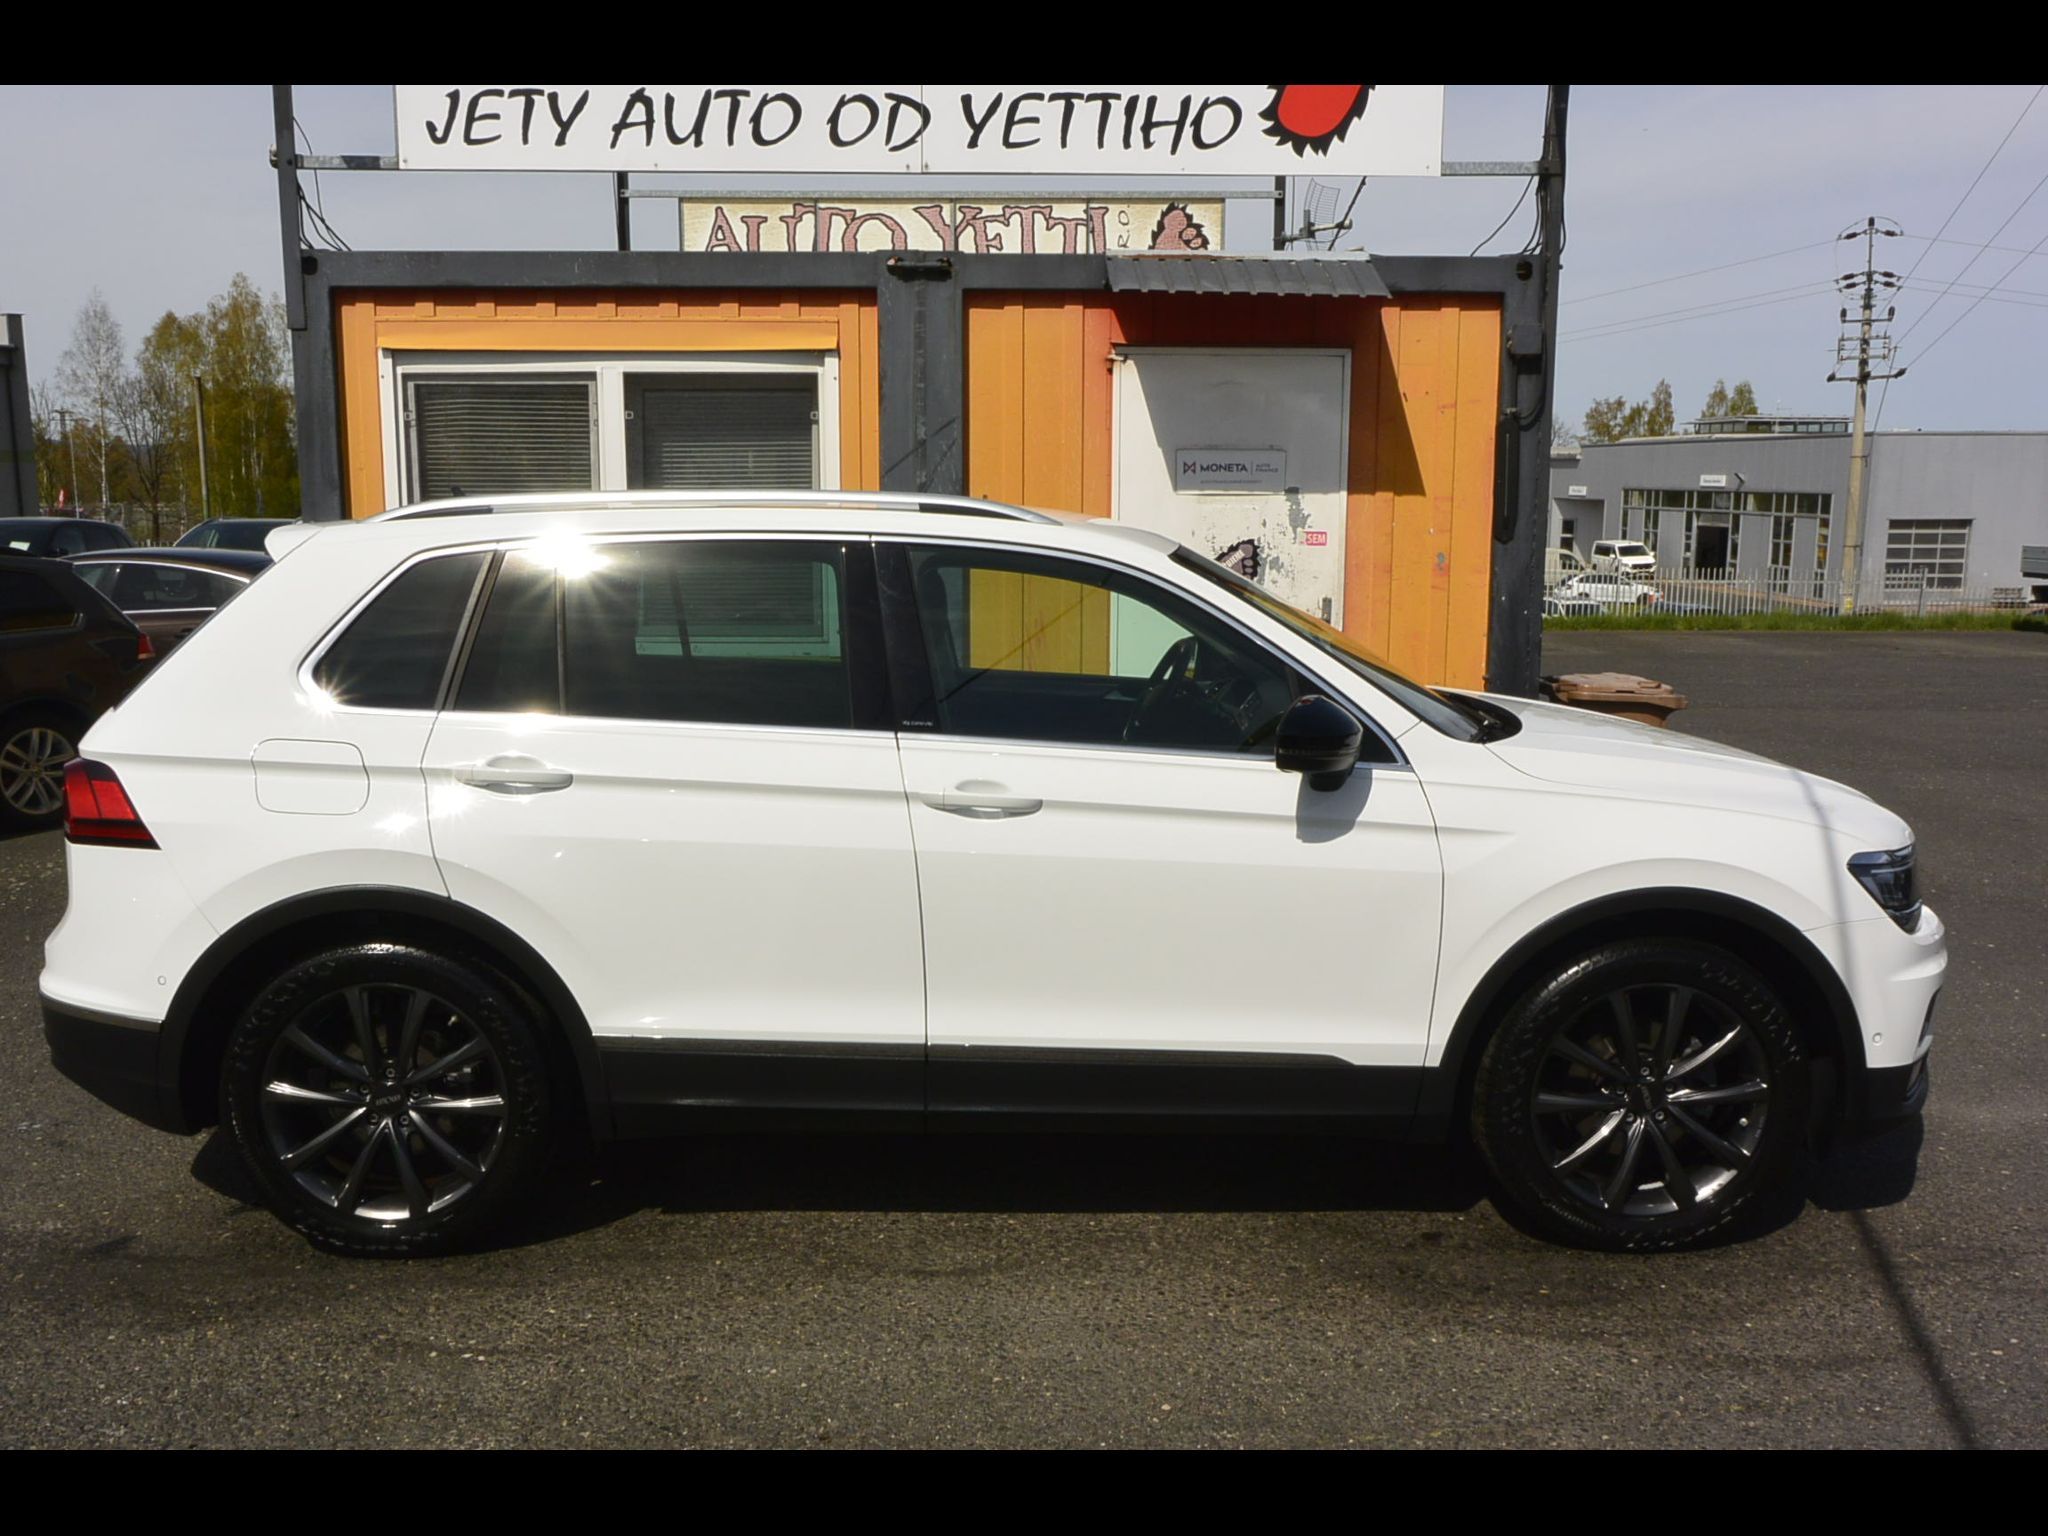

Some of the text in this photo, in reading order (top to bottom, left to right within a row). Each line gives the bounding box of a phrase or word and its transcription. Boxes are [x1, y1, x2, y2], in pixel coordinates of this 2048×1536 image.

[425, 87, 1243, 155] JETY AUTO OD YETTIHO
[1200, 463, 1248, 473] MONETA
[1306, 533, 1326, 544] SEM
